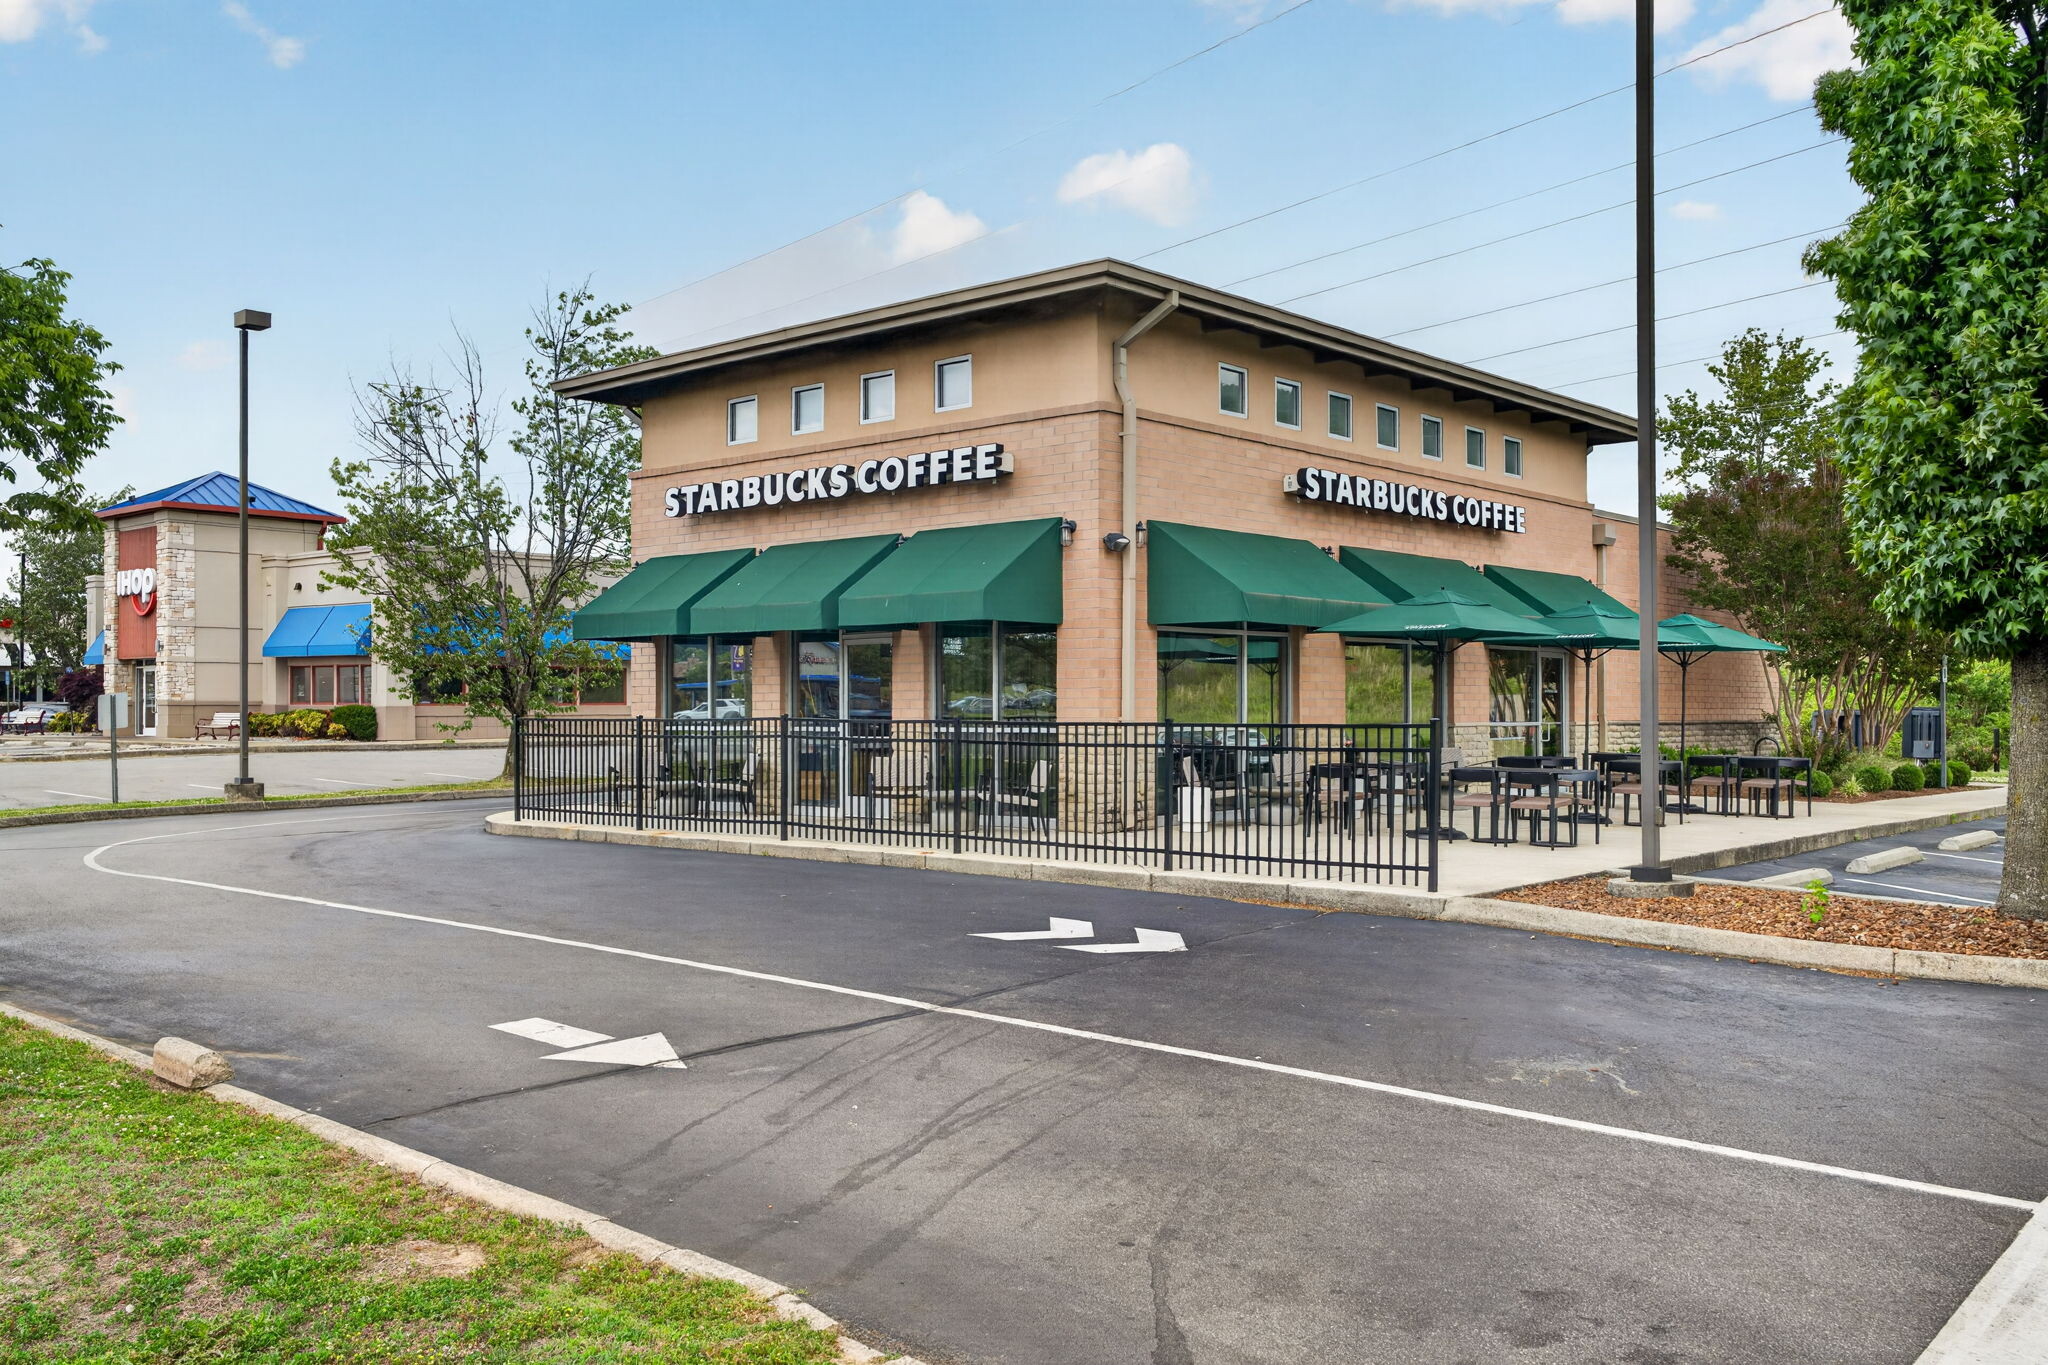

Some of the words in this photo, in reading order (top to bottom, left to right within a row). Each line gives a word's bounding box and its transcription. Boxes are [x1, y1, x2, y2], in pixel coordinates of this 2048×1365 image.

[664, 464, 849, 517] STARBUCKS
[858, 443, 998, 493] COFFEE
[1305, 467, 1447, 520] STARBUCKS
[1453, 495, 1526, 533] COFFEE
